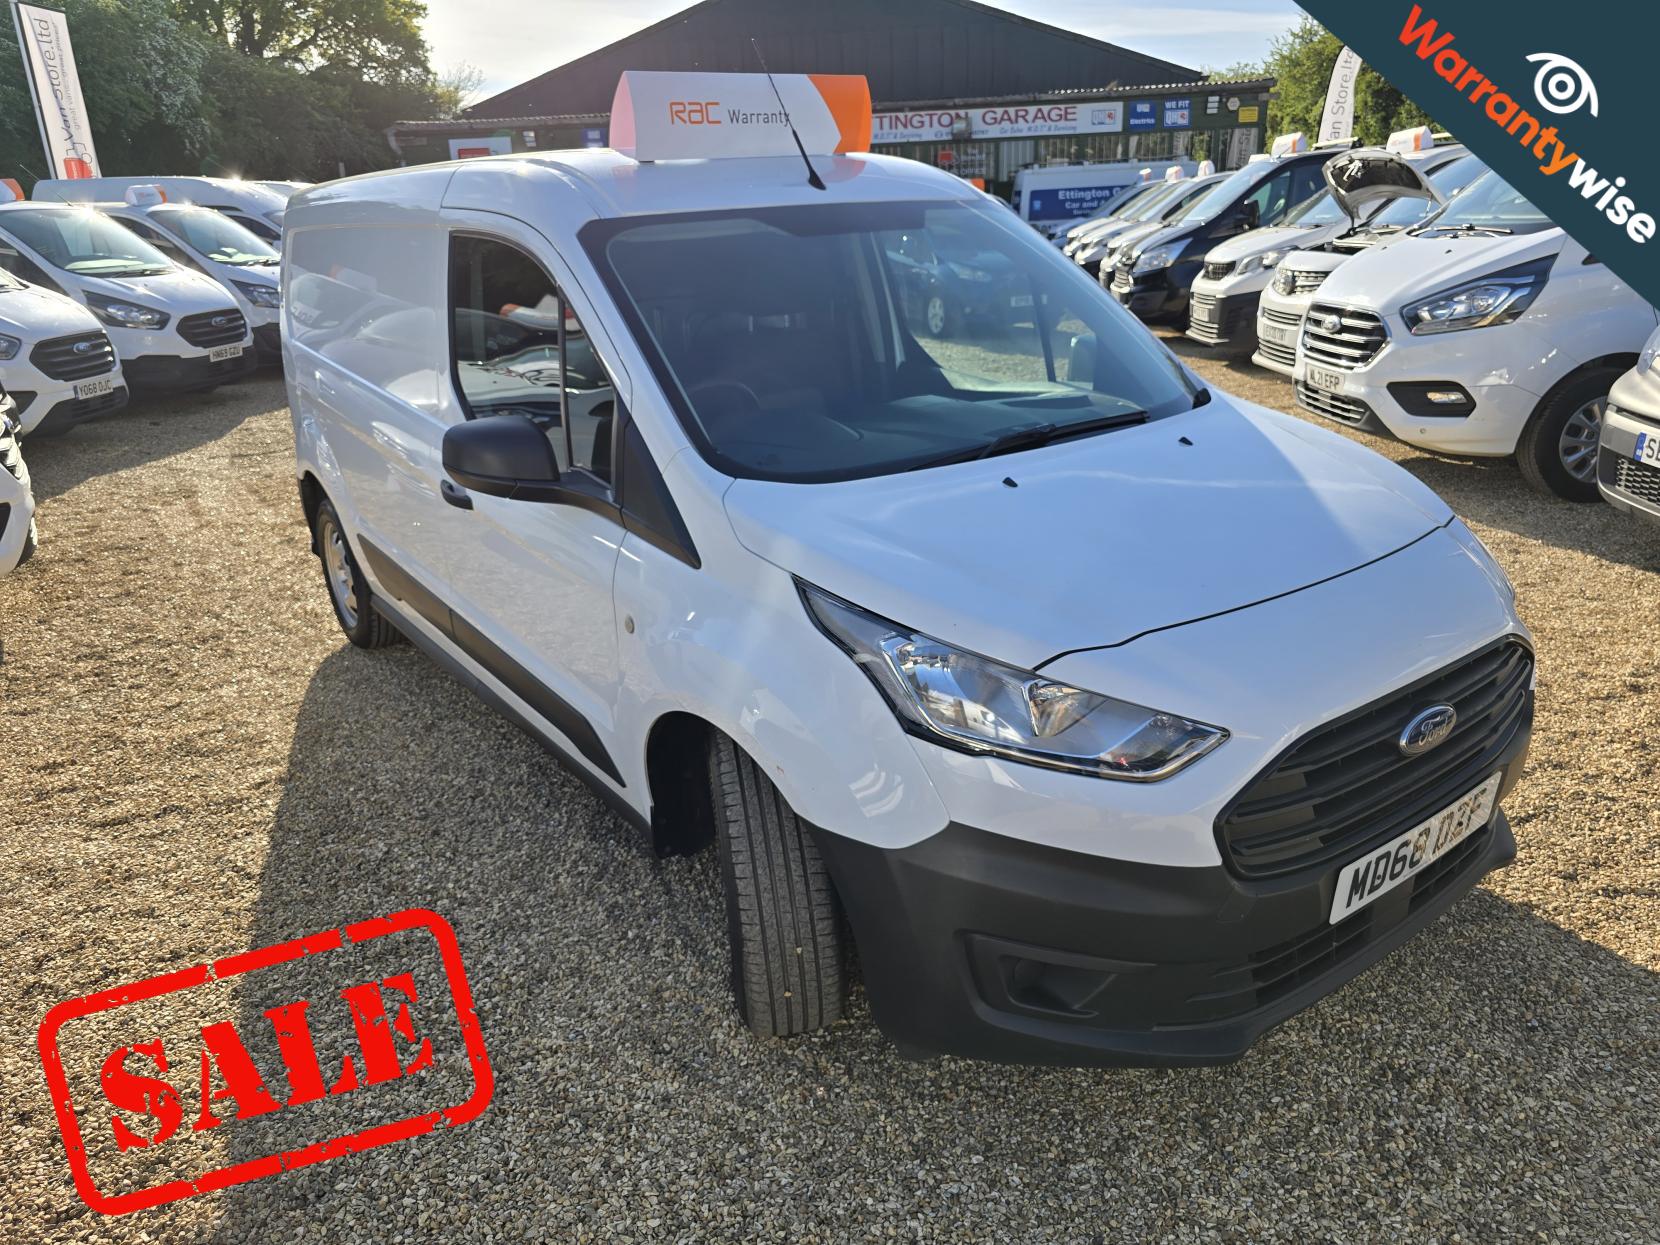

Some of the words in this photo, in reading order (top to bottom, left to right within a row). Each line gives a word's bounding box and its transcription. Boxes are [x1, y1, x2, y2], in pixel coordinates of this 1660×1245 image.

[60, 106, 74, 142] Van
[727, 108, 790, 127] Warranty
[982, 105, 1078, 126] GARAGE
[1326, 120, 1343, 142] an
[1058, 188, 1110, 201] Ettington
[1418, 715, 1450, 746] Ford
